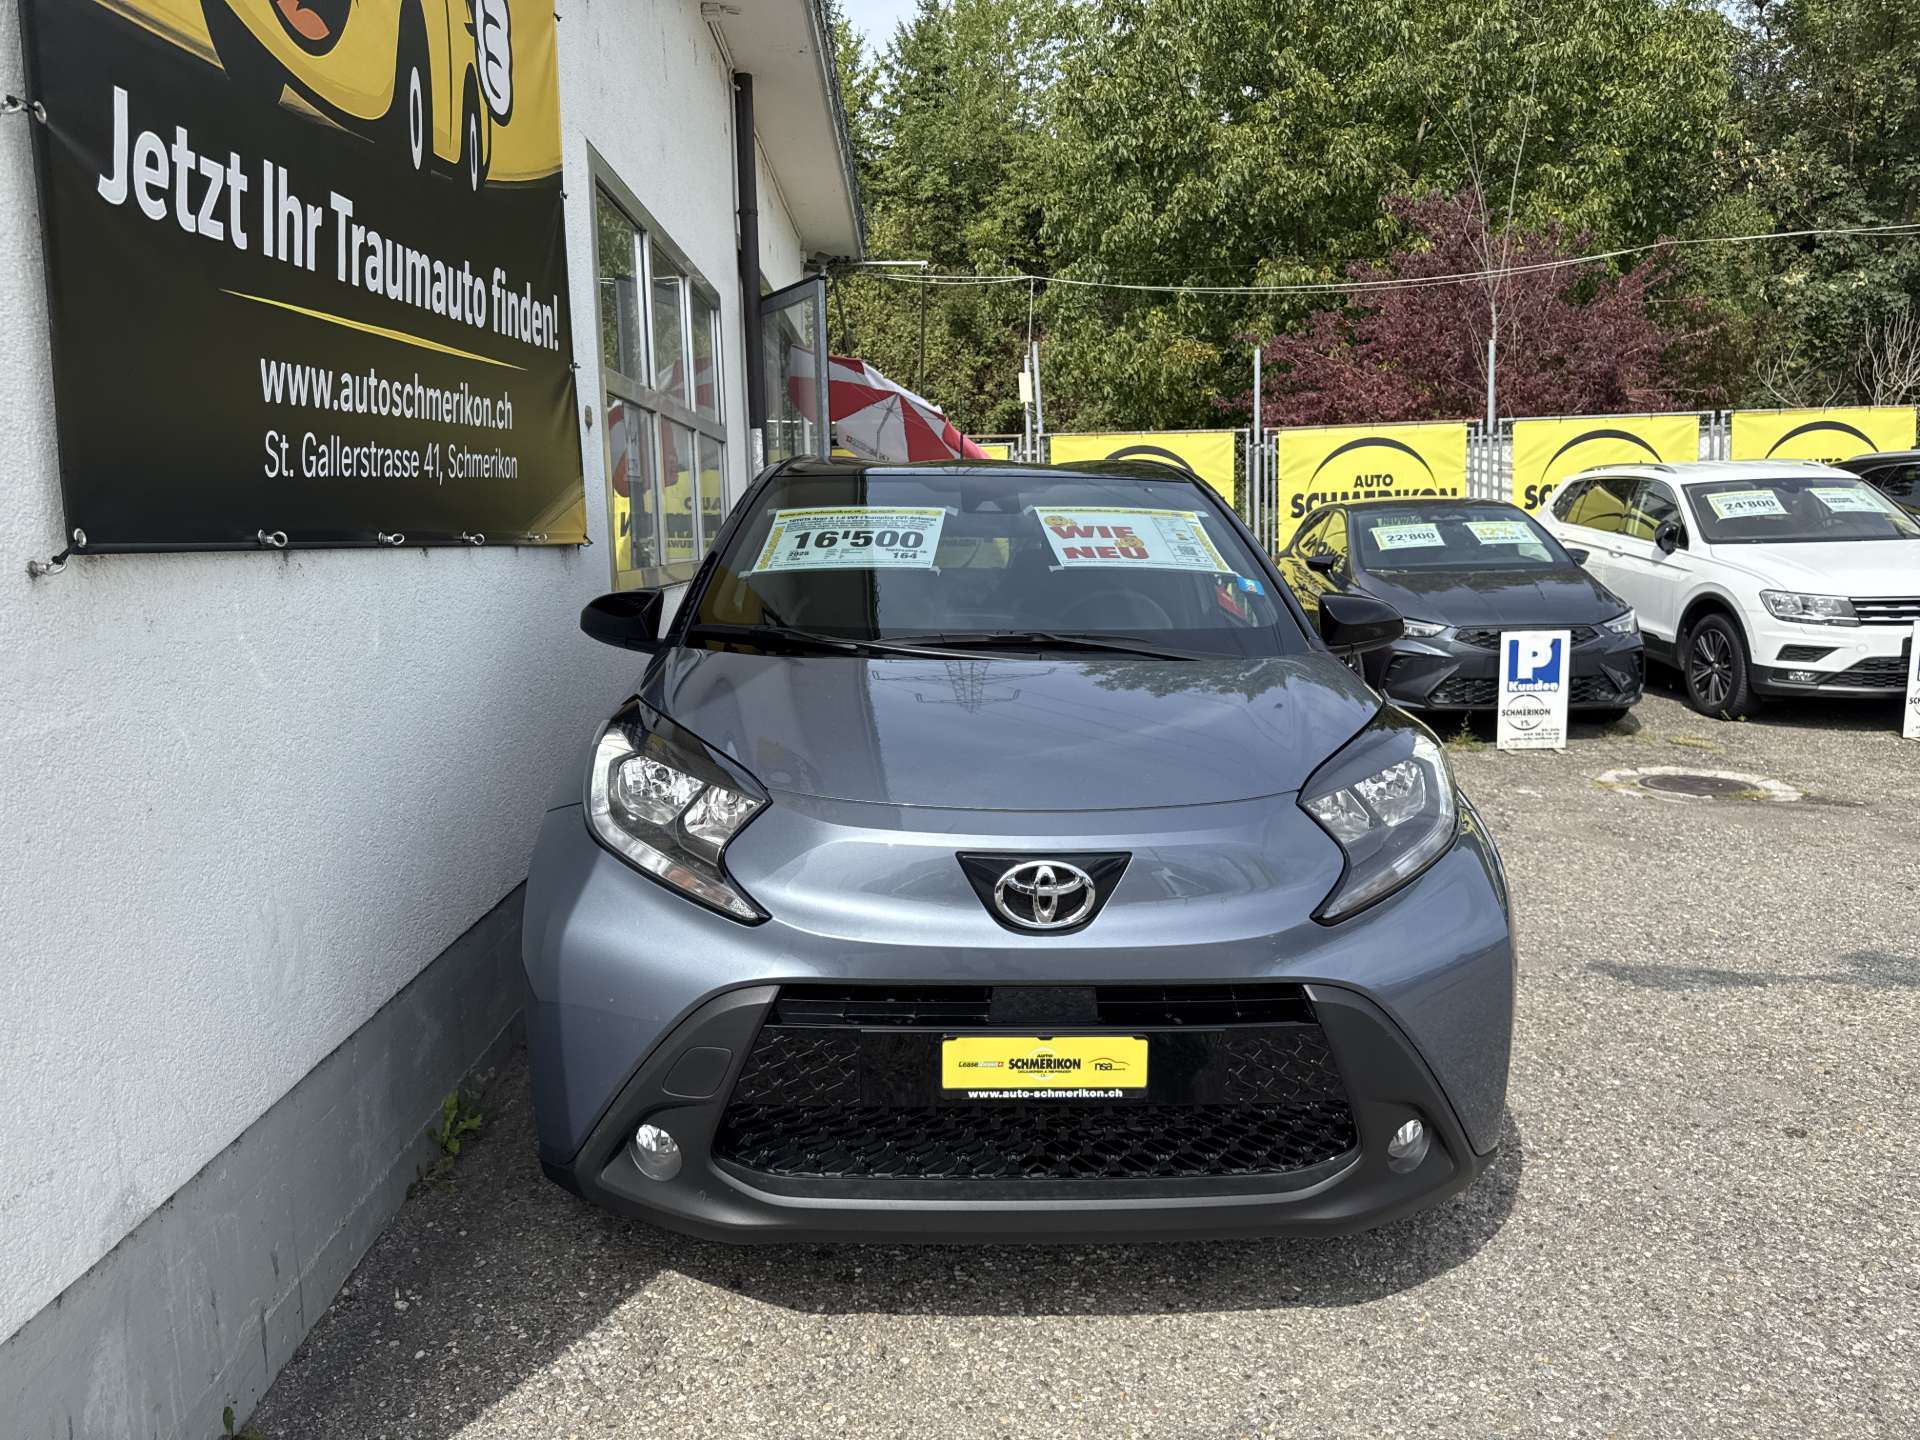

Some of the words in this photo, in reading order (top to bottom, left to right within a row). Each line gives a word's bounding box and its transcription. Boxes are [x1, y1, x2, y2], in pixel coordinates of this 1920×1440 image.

[97, 85, 248, 250] Jetzt
[263, 159, 323, 272] Ihr
[330, 191, 486, 329] Traumauto
[491, 266, 559, 352] finden!
[260, 357, 514, 430] www.autoschmerikon.ch
[264, 430, 295, 479] St.
[301, 431, 420, 479] Gallerstrasse
[424, 442, 444, 486] 41,
[447, 444, 518, 480] Schmerikon
[1353, 473, 1394, 488] AUTO
[1724, 499, 1776, 511] 24'800
[794, 530, 924, 549] 16'500
[1050, 526, 1134, 540] WIE
[1386, 532, 1436, 542] 22'800
[1062, 546, 1150, 560] NEU
[1517, 638, 1553, 680] P
[1507, 680, 1560, 693] Kunden
[1501, 707, 1551, 717] SCHMERIKON
[1008, 1058, 1081, 1070] SCHMERIKON
[968, 1088, 1123, 1098] www.auto-schmerikon.ch
